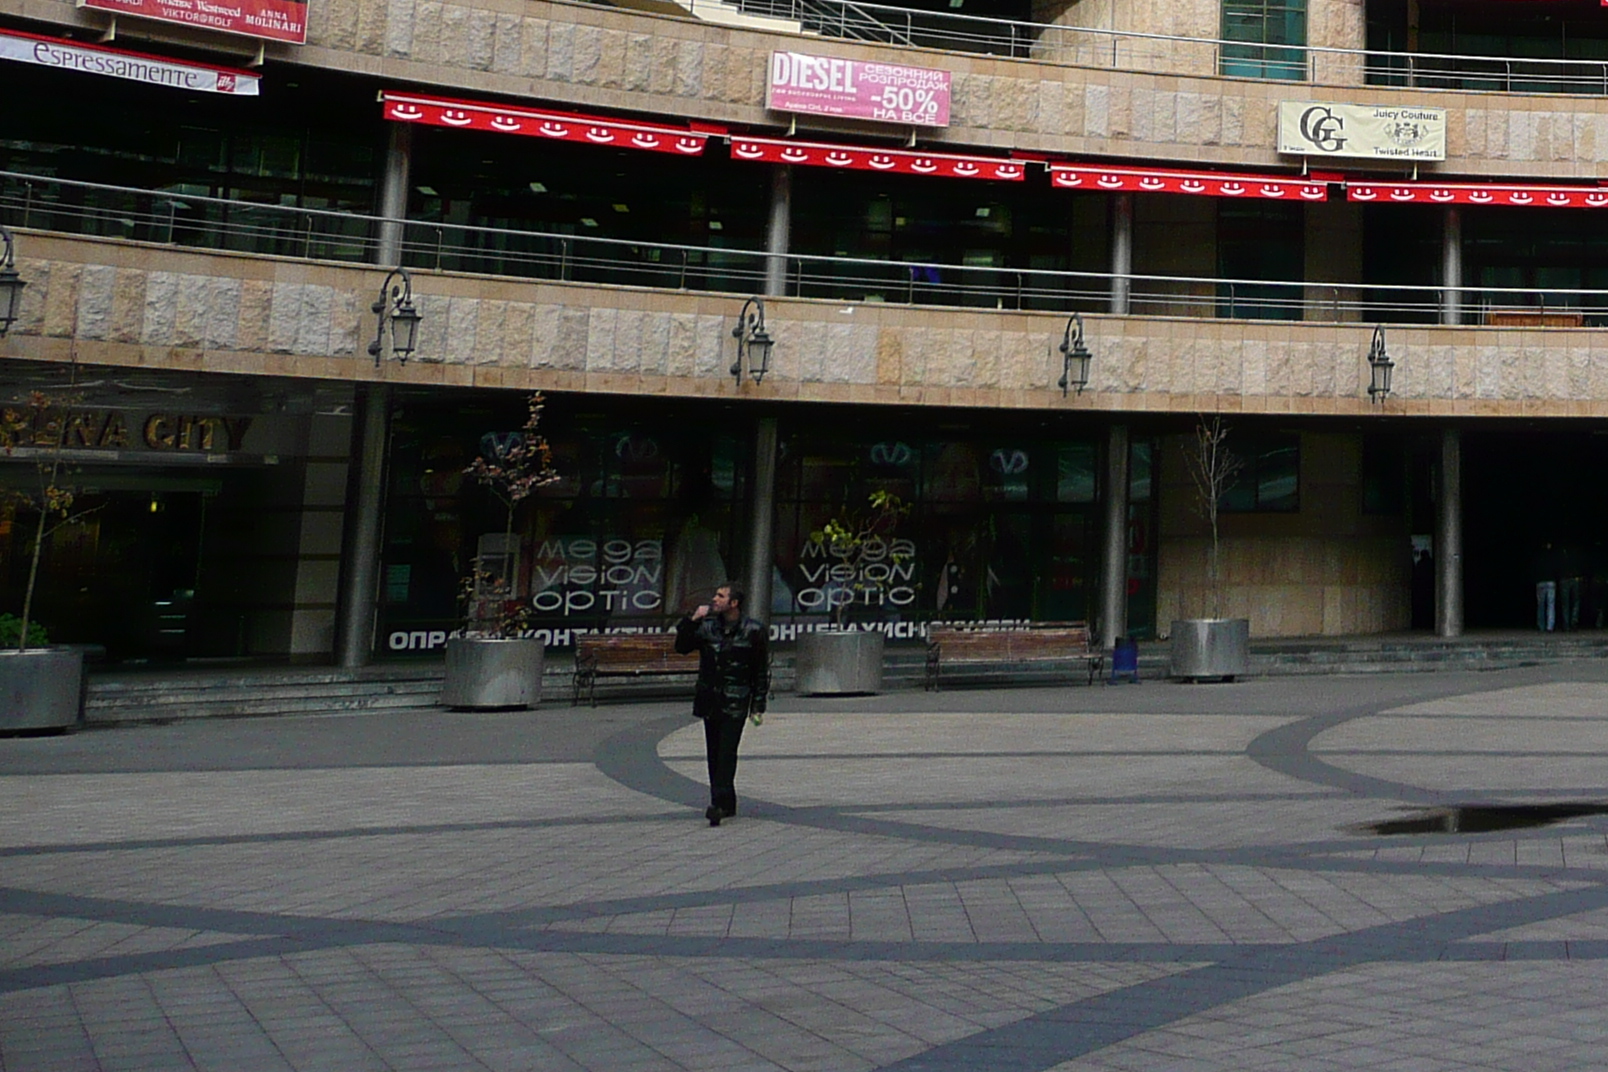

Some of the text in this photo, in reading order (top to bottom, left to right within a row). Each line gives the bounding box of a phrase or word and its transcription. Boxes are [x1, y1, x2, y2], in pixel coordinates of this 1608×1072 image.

[260, 9, 287, 20] ANNA
[246, 14, 301, 33] MOLINARI
[772, 52, 857, 93] DIESEL
[865, 64, 943, 81] СЕЗОННИЙ
[859, 73, 948, 91] РОЗПРОДАЖ
[871, 86, 938, 114] -50%
[874, 108, 936, 124] НА ВСЕ
[1373, 109, 1438, 121] Juicy Couture
[1373, 147, 1437, 157] Twisted Heart
[143, 412, 252, 450] CITY
